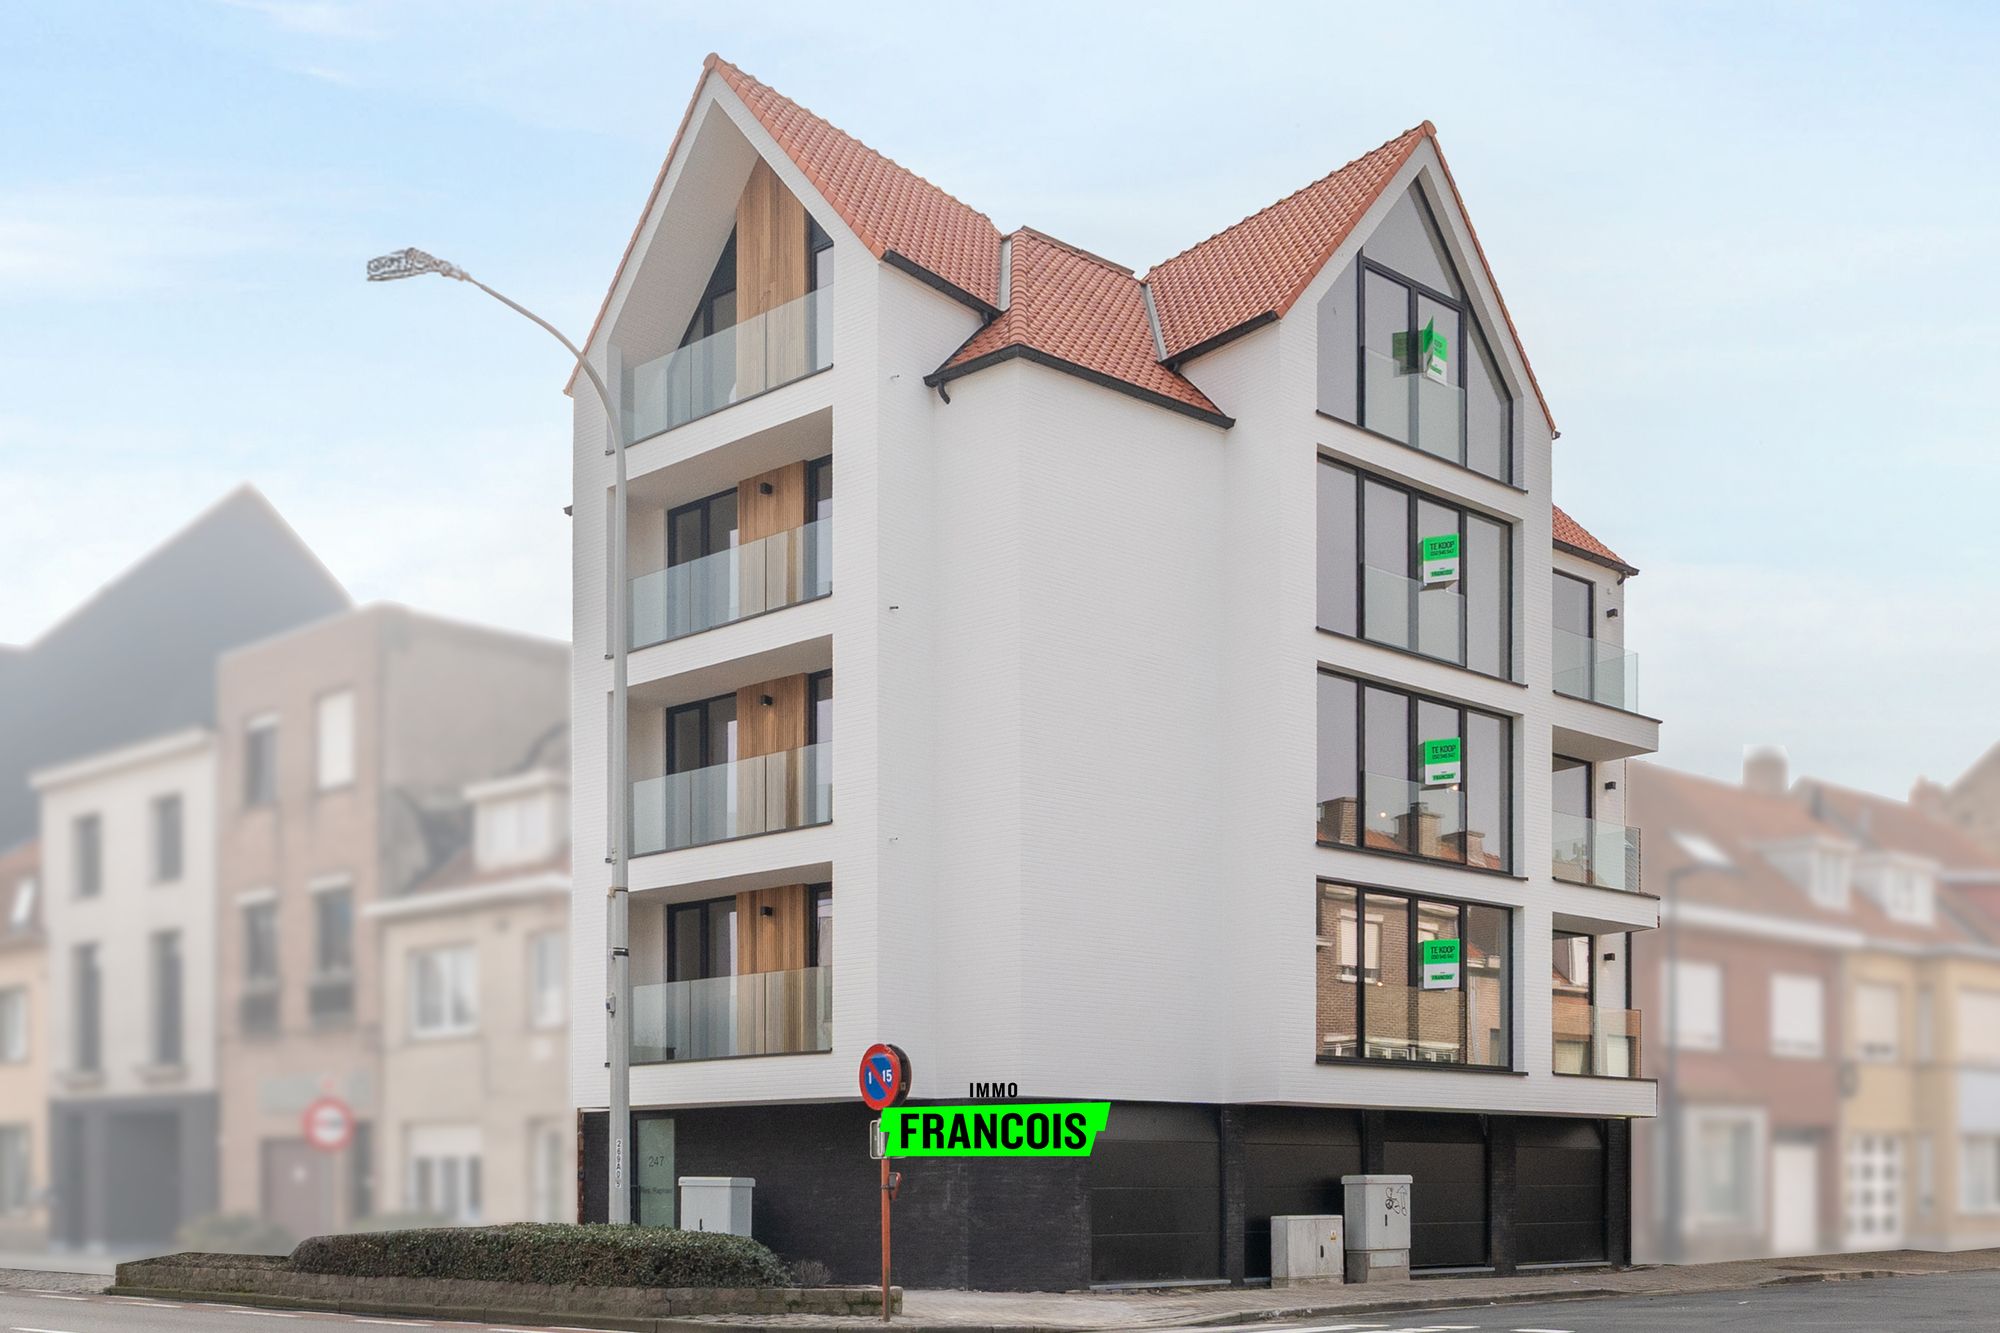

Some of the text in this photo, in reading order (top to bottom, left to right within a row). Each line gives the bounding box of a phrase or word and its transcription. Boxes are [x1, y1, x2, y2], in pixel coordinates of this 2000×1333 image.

[868, 1069, 893, 1085] 1 15
[648, 1155, 665, 1167] 247
